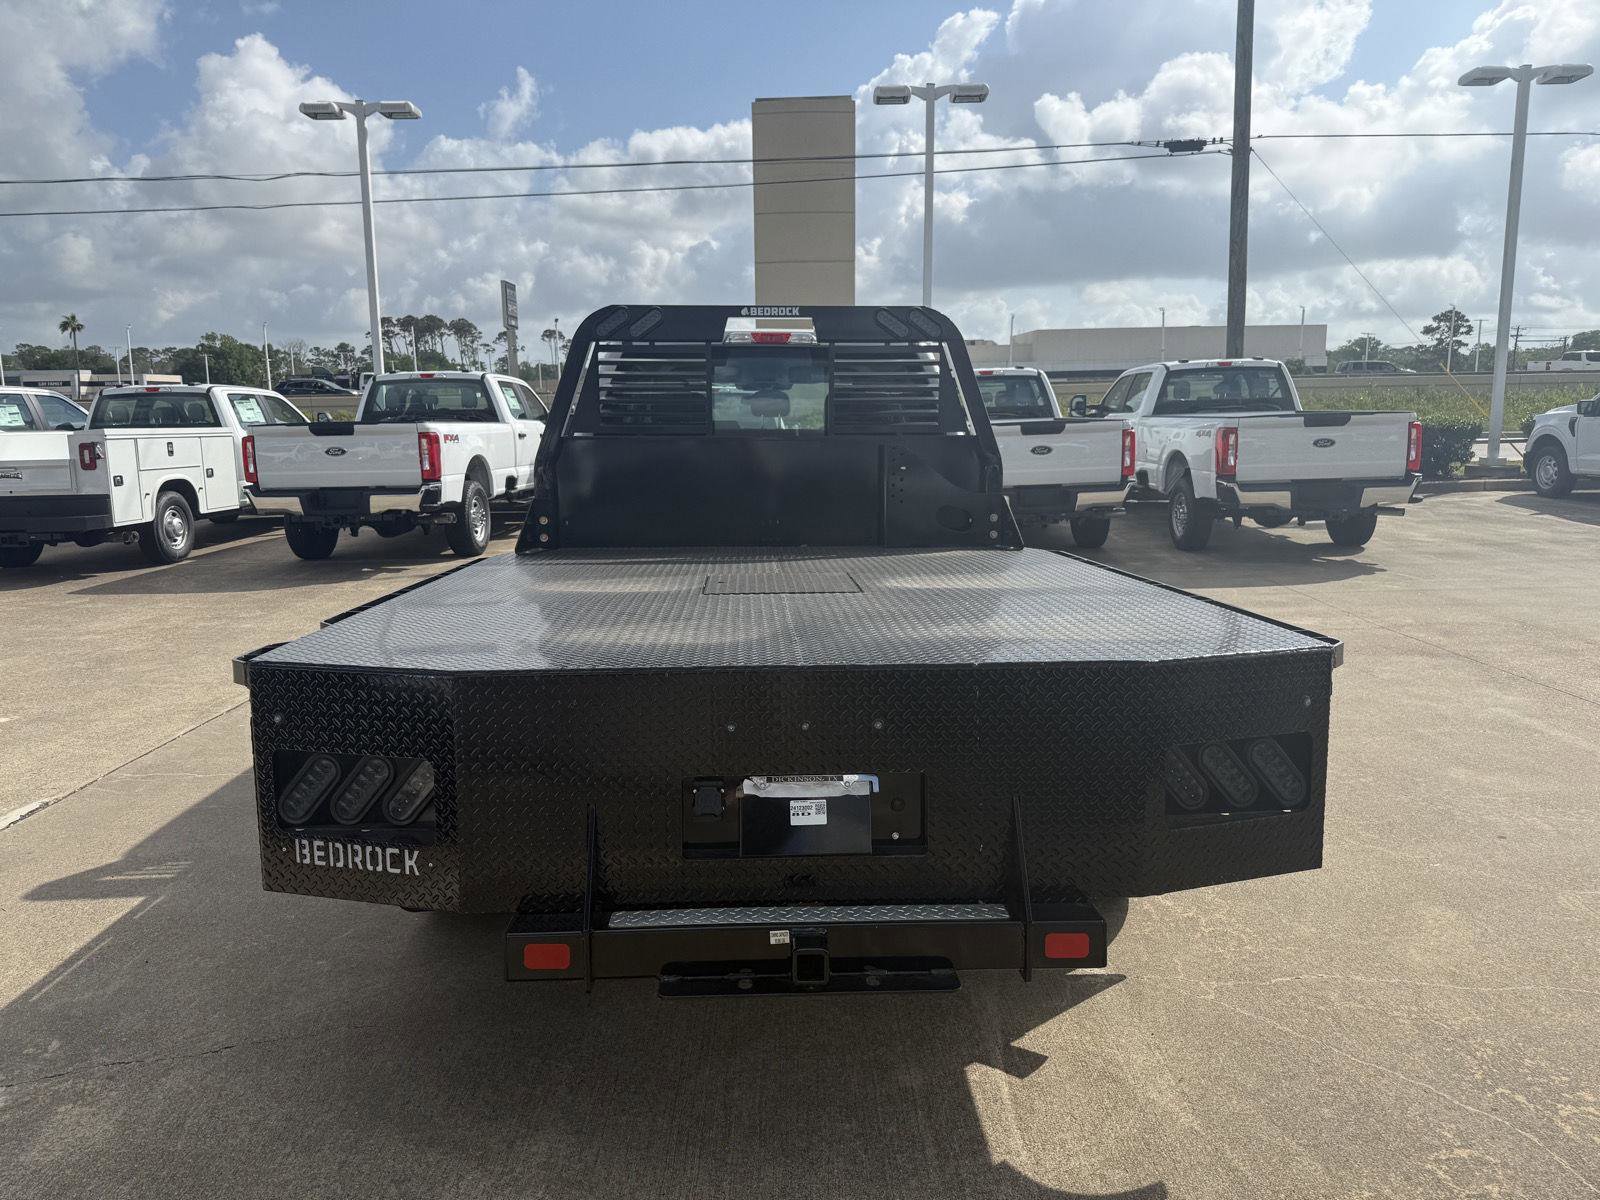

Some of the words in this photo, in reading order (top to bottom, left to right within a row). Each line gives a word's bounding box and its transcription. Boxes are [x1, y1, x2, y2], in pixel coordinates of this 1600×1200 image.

[750, 307, 799, 316] BEDROCK
[327, 448, 344, 456] Ford
[295, 839, 420, 876] BEDROCK
